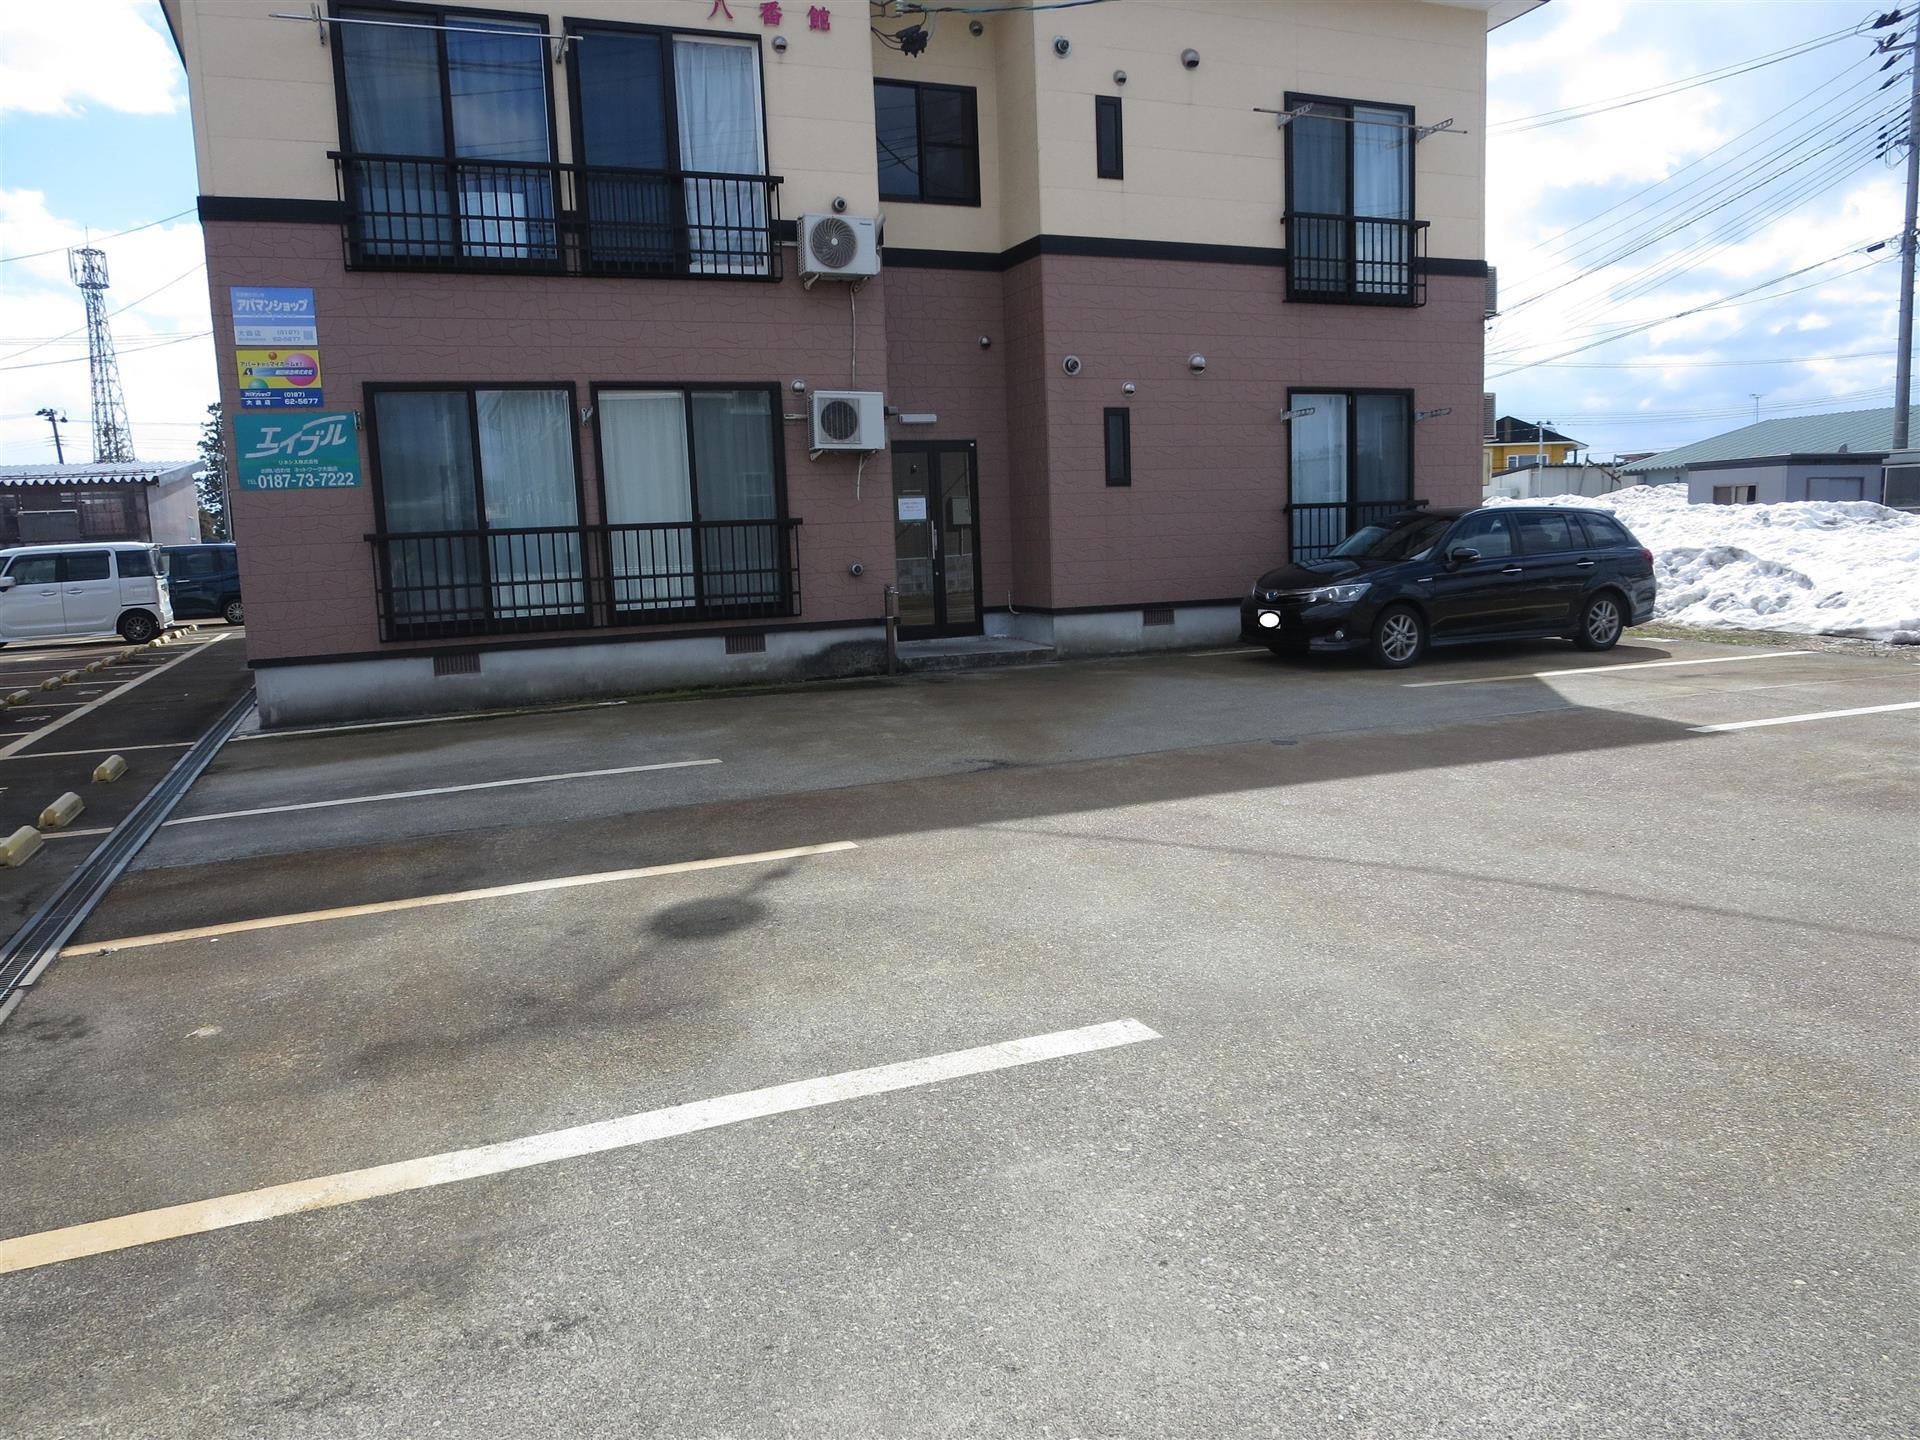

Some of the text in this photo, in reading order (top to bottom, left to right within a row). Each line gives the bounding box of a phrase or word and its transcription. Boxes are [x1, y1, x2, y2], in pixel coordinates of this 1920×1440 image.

[709, 0, 830, 31] 八番館
[236, 298, 308, 312] アパマンショップ
[245, 415, 347, 458] エイブル
[257, 472, 355, 488] 0187-73-7222
